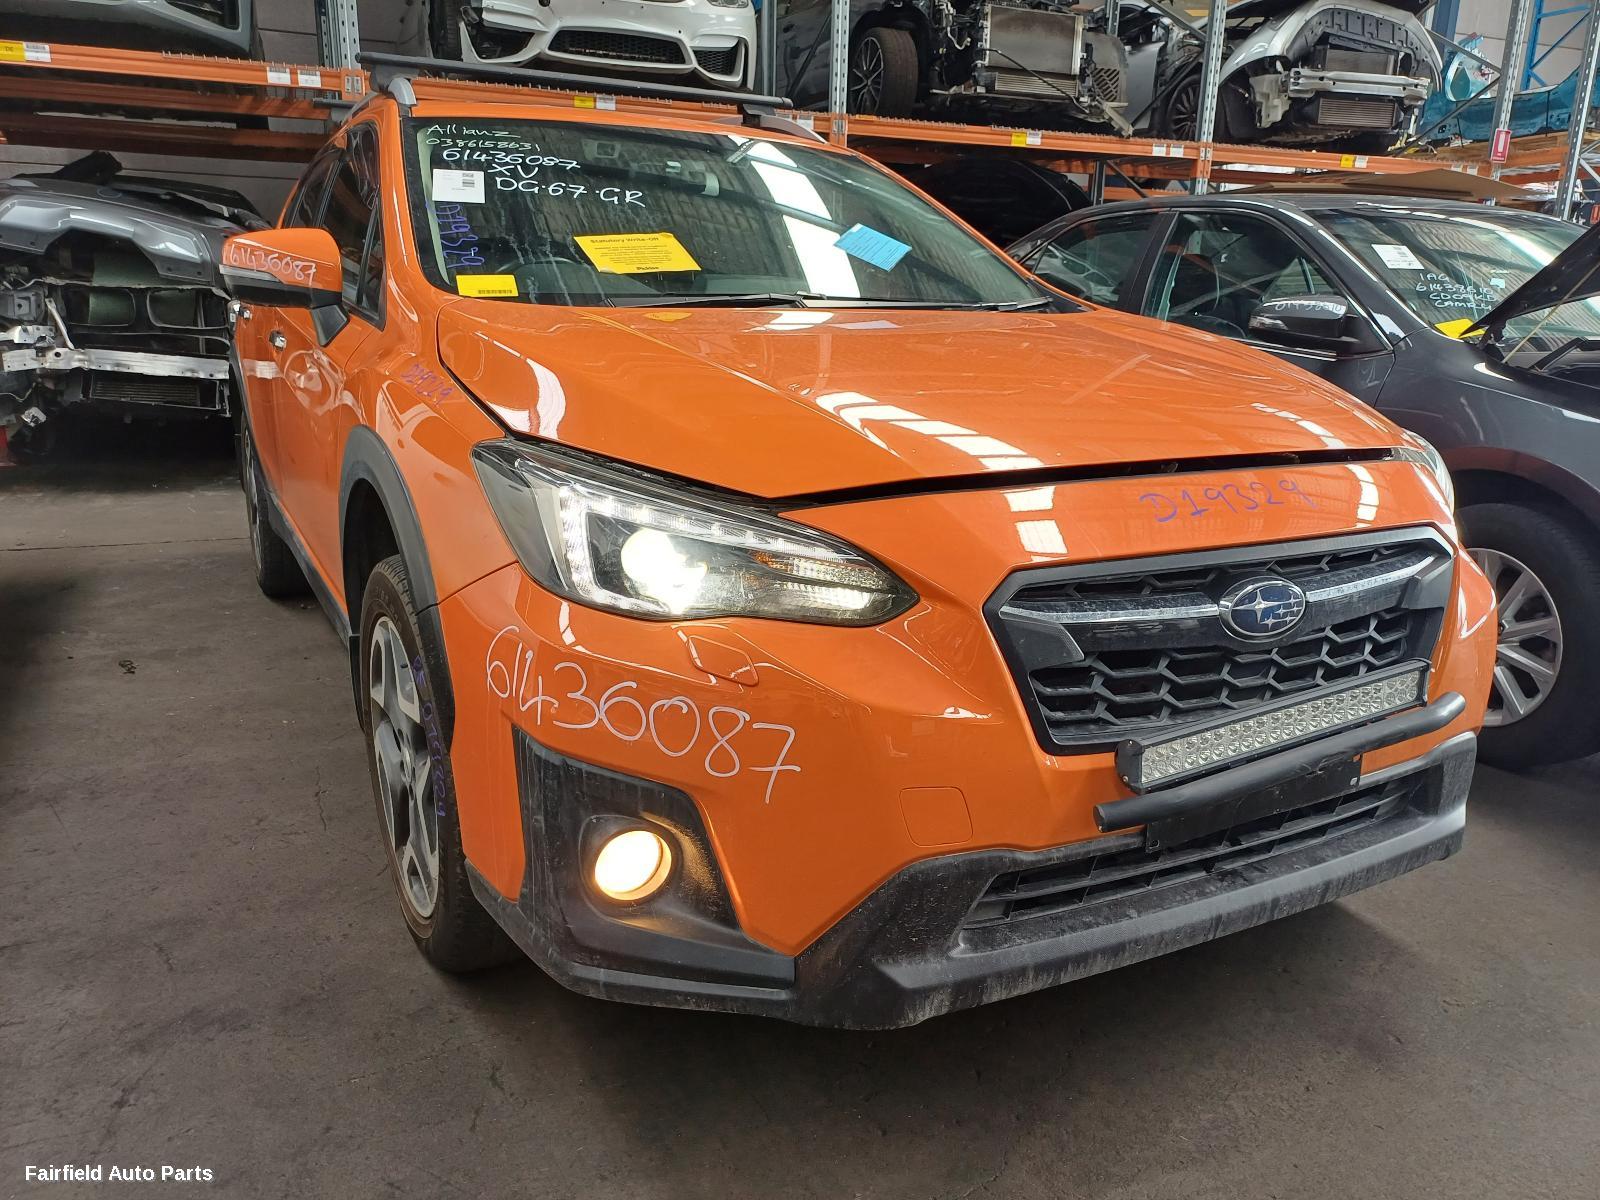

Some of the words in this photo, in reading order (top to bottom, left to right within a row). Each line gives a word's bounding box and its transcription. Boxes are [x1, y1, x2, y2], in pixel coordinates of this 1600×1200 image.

[427, 124, 521, 138] Allianz
[443, 148, 581, 170] 61436087
[488, 163, 538, 179] XV
[230, 244, 316, 287] 61436087
[1139, 479, 1318, 522] D19329
[487, 626, 801, 804] 61436087
